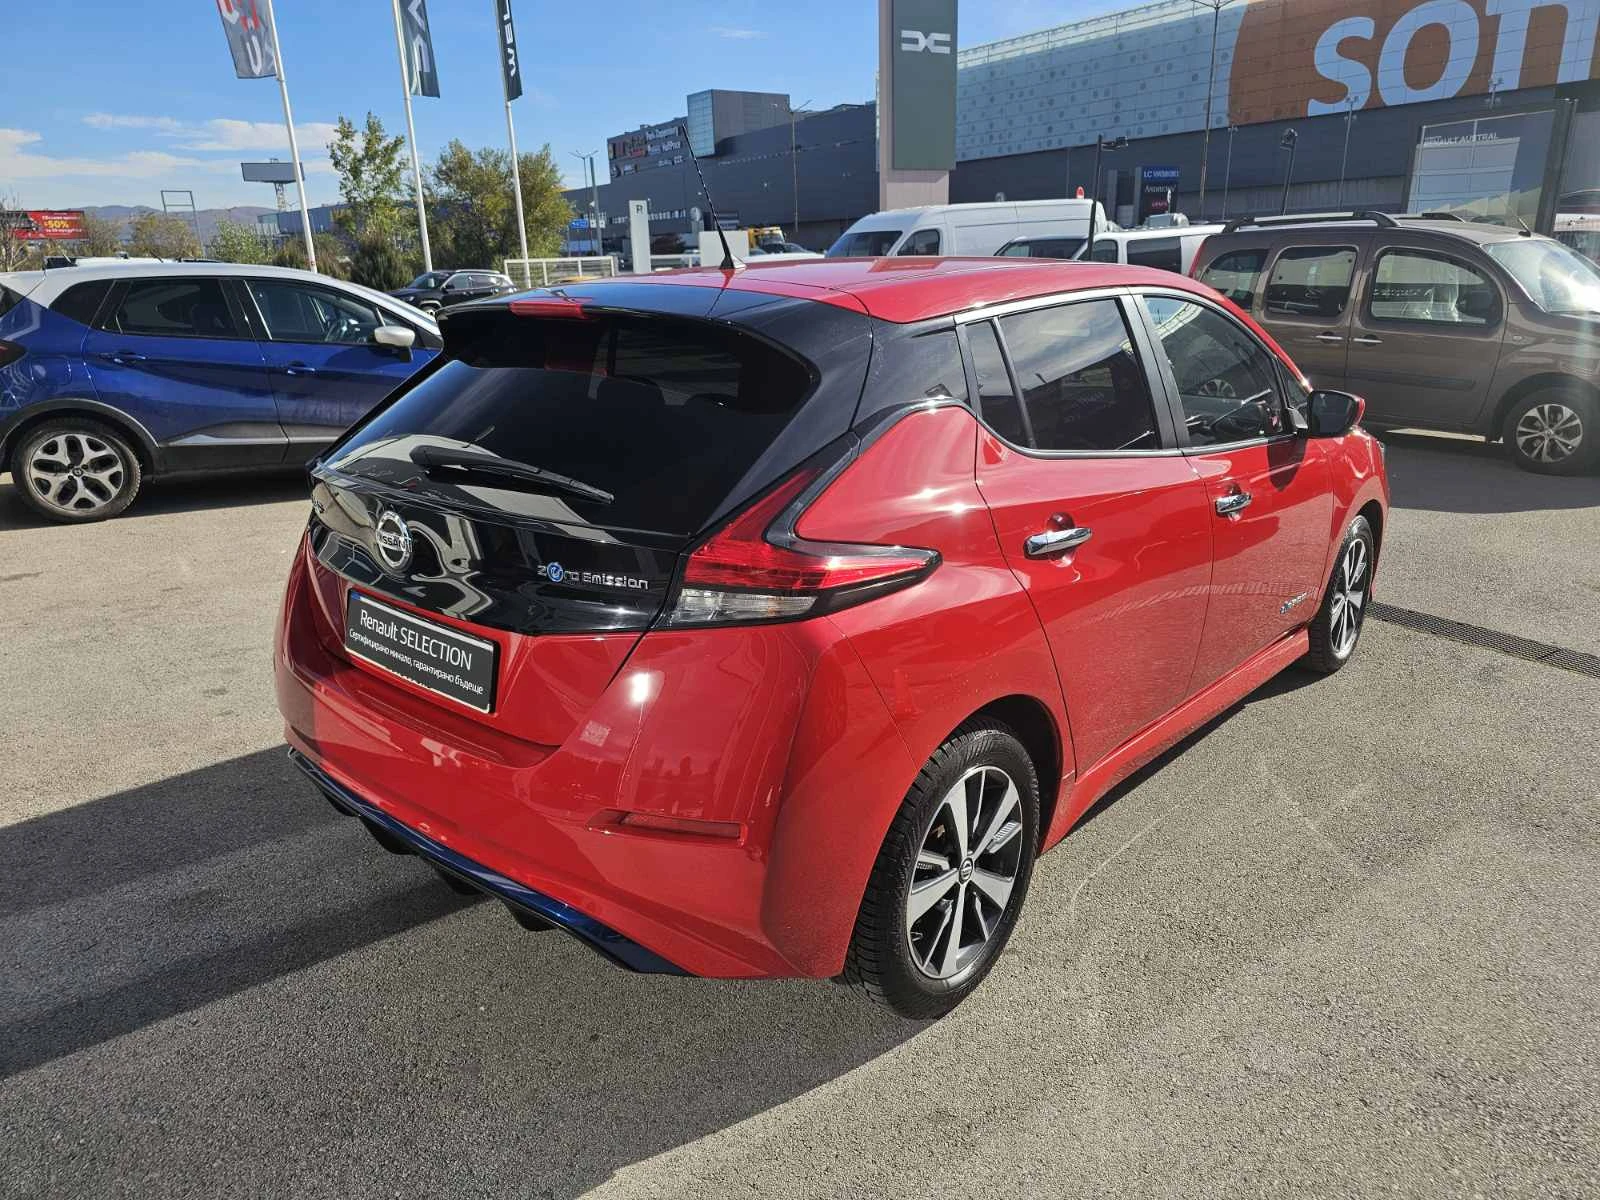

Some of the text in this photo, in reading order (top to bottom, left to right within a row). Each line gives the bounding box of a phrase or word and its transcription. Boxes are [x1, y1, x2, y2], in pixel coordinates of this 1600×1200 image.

[583, 572, 649, 590] Emission
[349, 628, 484, 695] Сертифицирано минало, гарантирано бъдеще
[360, 609, 472, 671] Renault SELECTION
